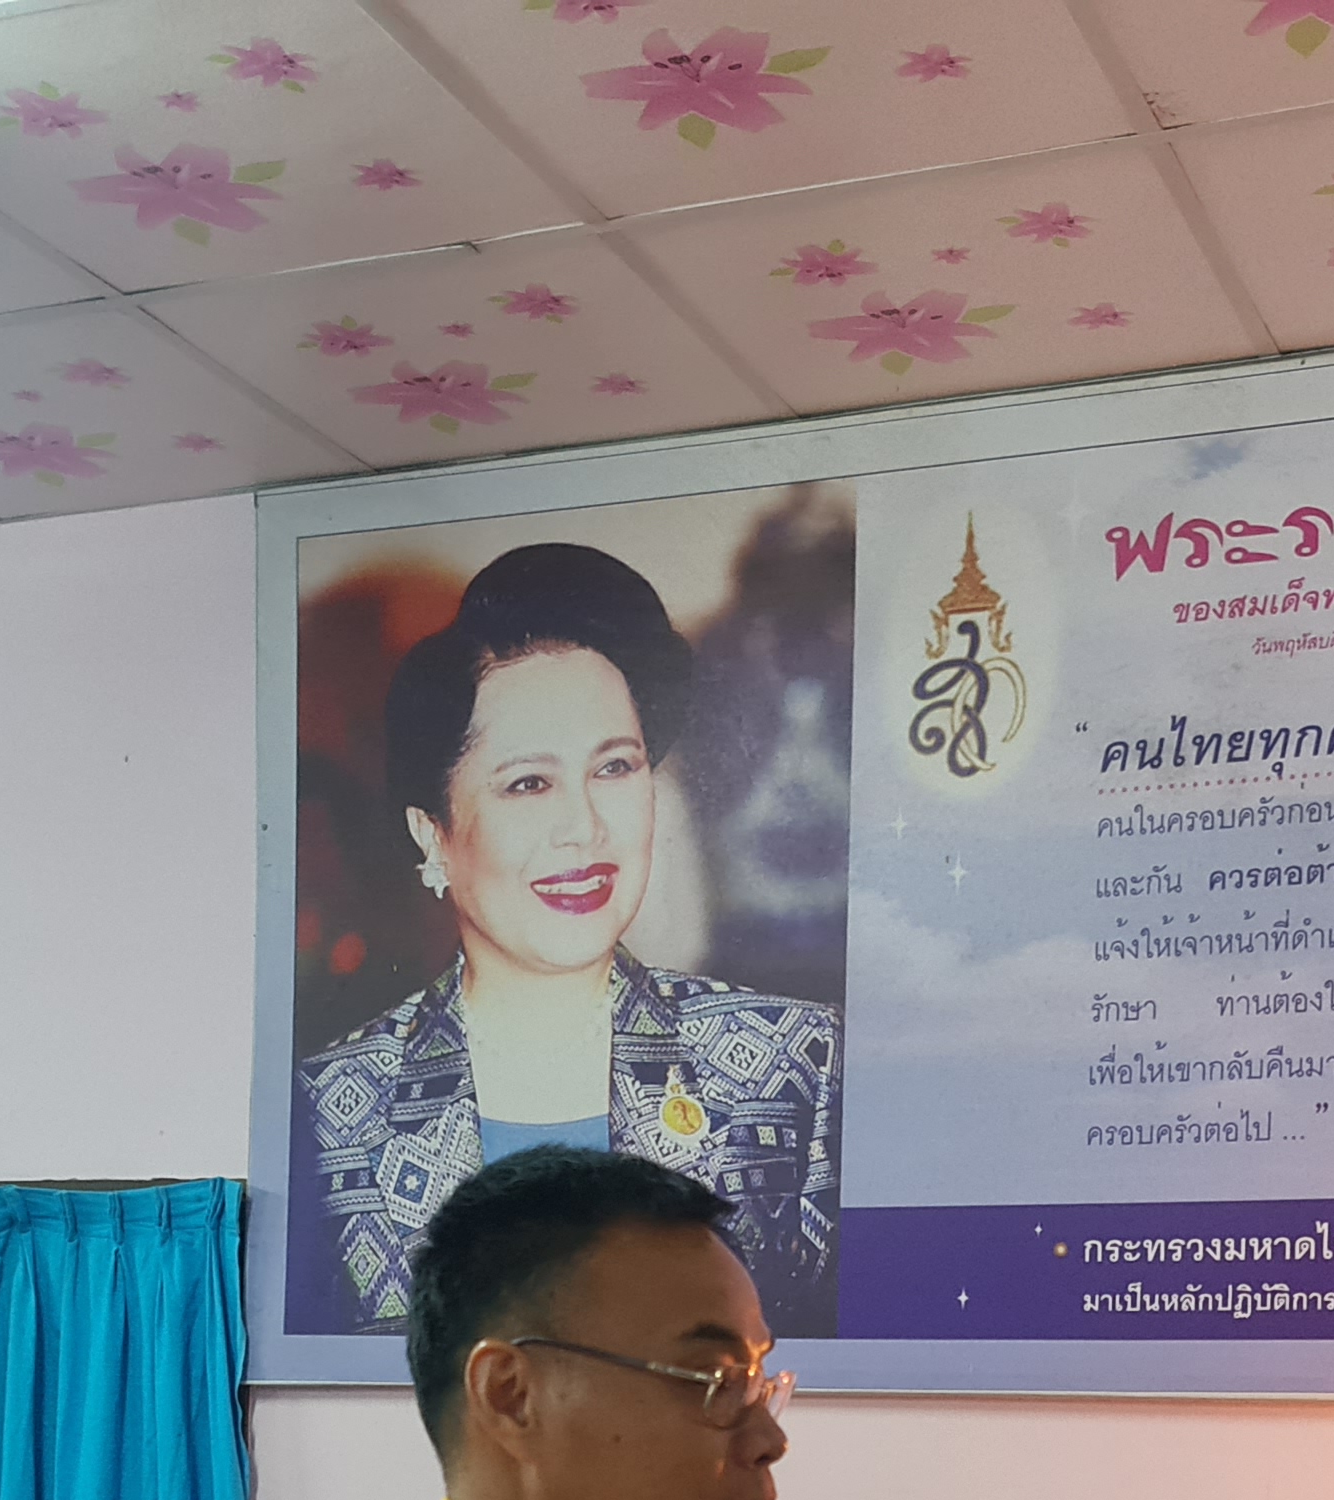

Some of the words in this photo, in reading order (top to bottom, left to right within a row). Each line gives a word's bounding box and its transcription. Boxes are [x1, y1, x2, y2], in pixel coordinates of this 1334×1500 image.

[1095, 865, 1183, 899] และกัน
[1091, 993, 1158, 1025] รักษา
[1086, 1102, 1273, 1147] ครอบครัวต่อไป
